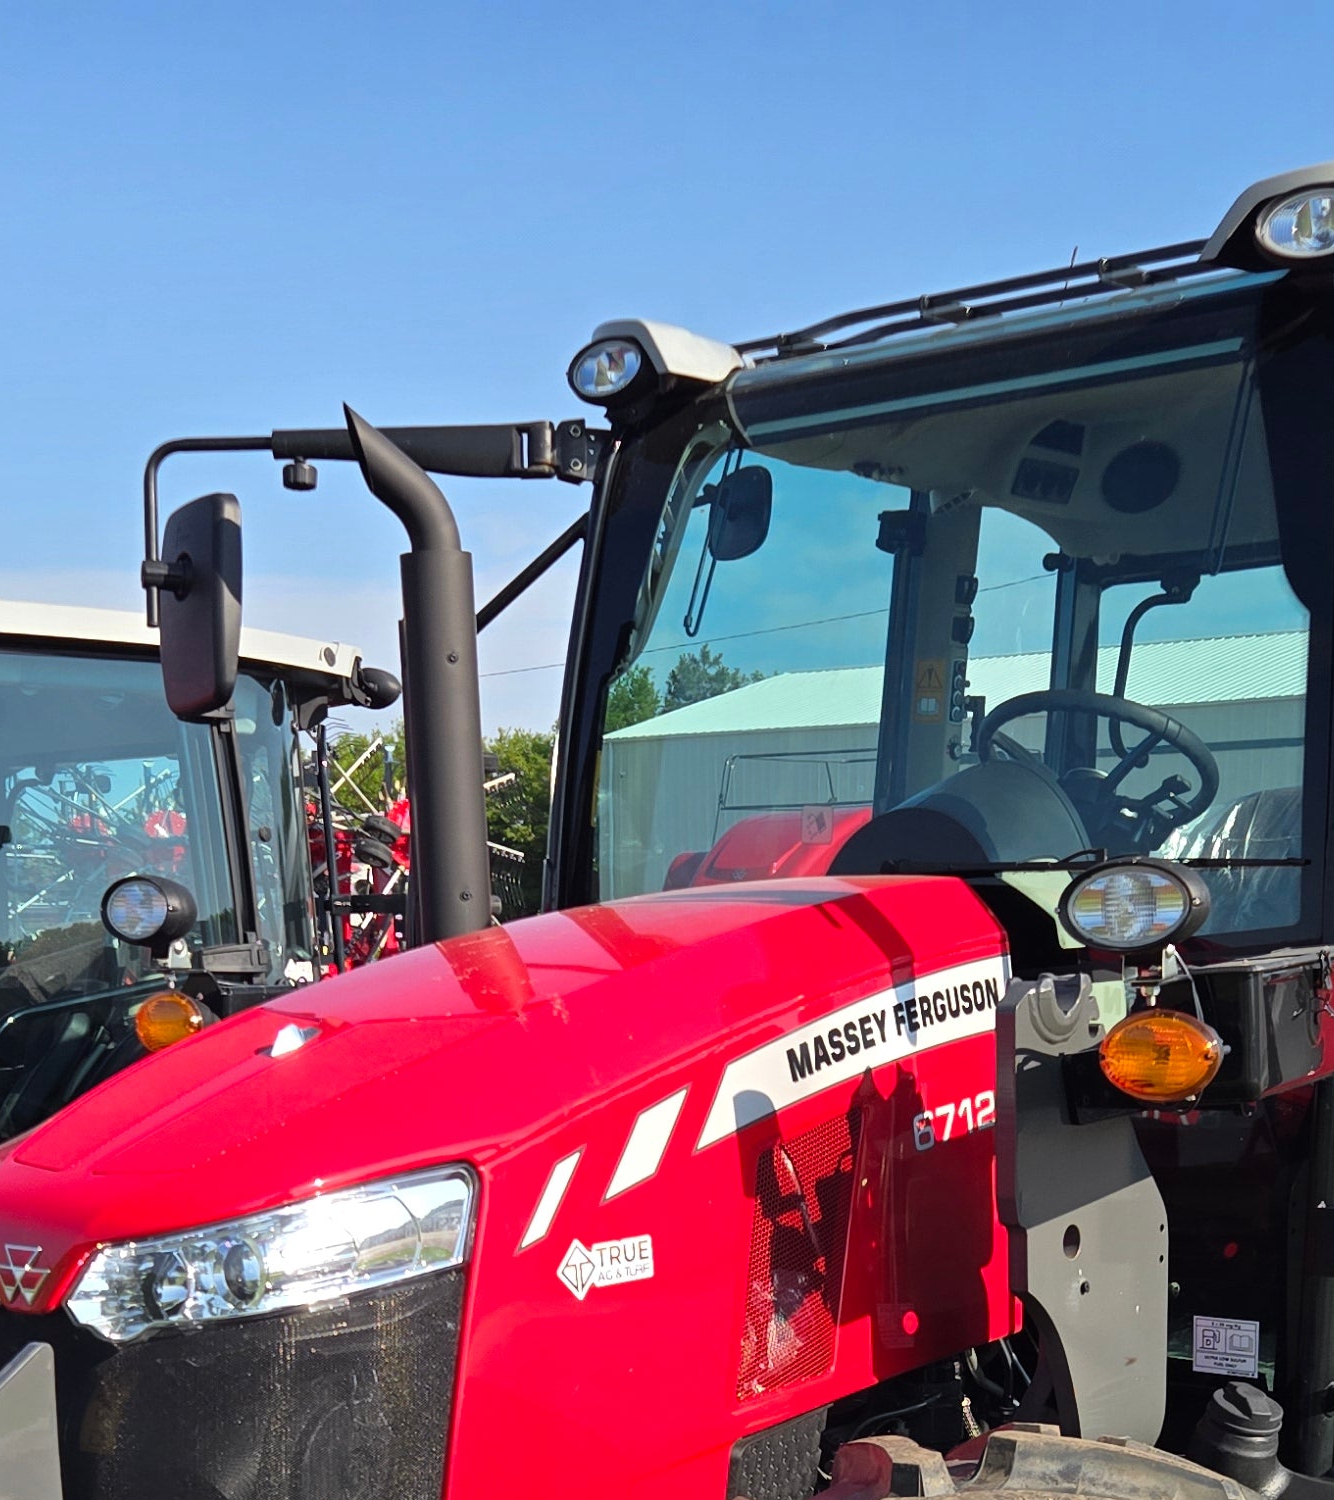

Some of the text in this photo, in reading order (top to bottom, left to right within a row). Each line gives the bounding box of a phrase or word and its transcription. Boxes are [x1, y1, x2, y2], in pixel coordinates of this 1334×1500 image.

[785, 977, 1001, 1083] MASSEY FERGUSON
[912, 1089, 997, 1151] 6712
[595, 1239, 650, 1268] TRUE
[597, 1270, 613, 1282] AG
